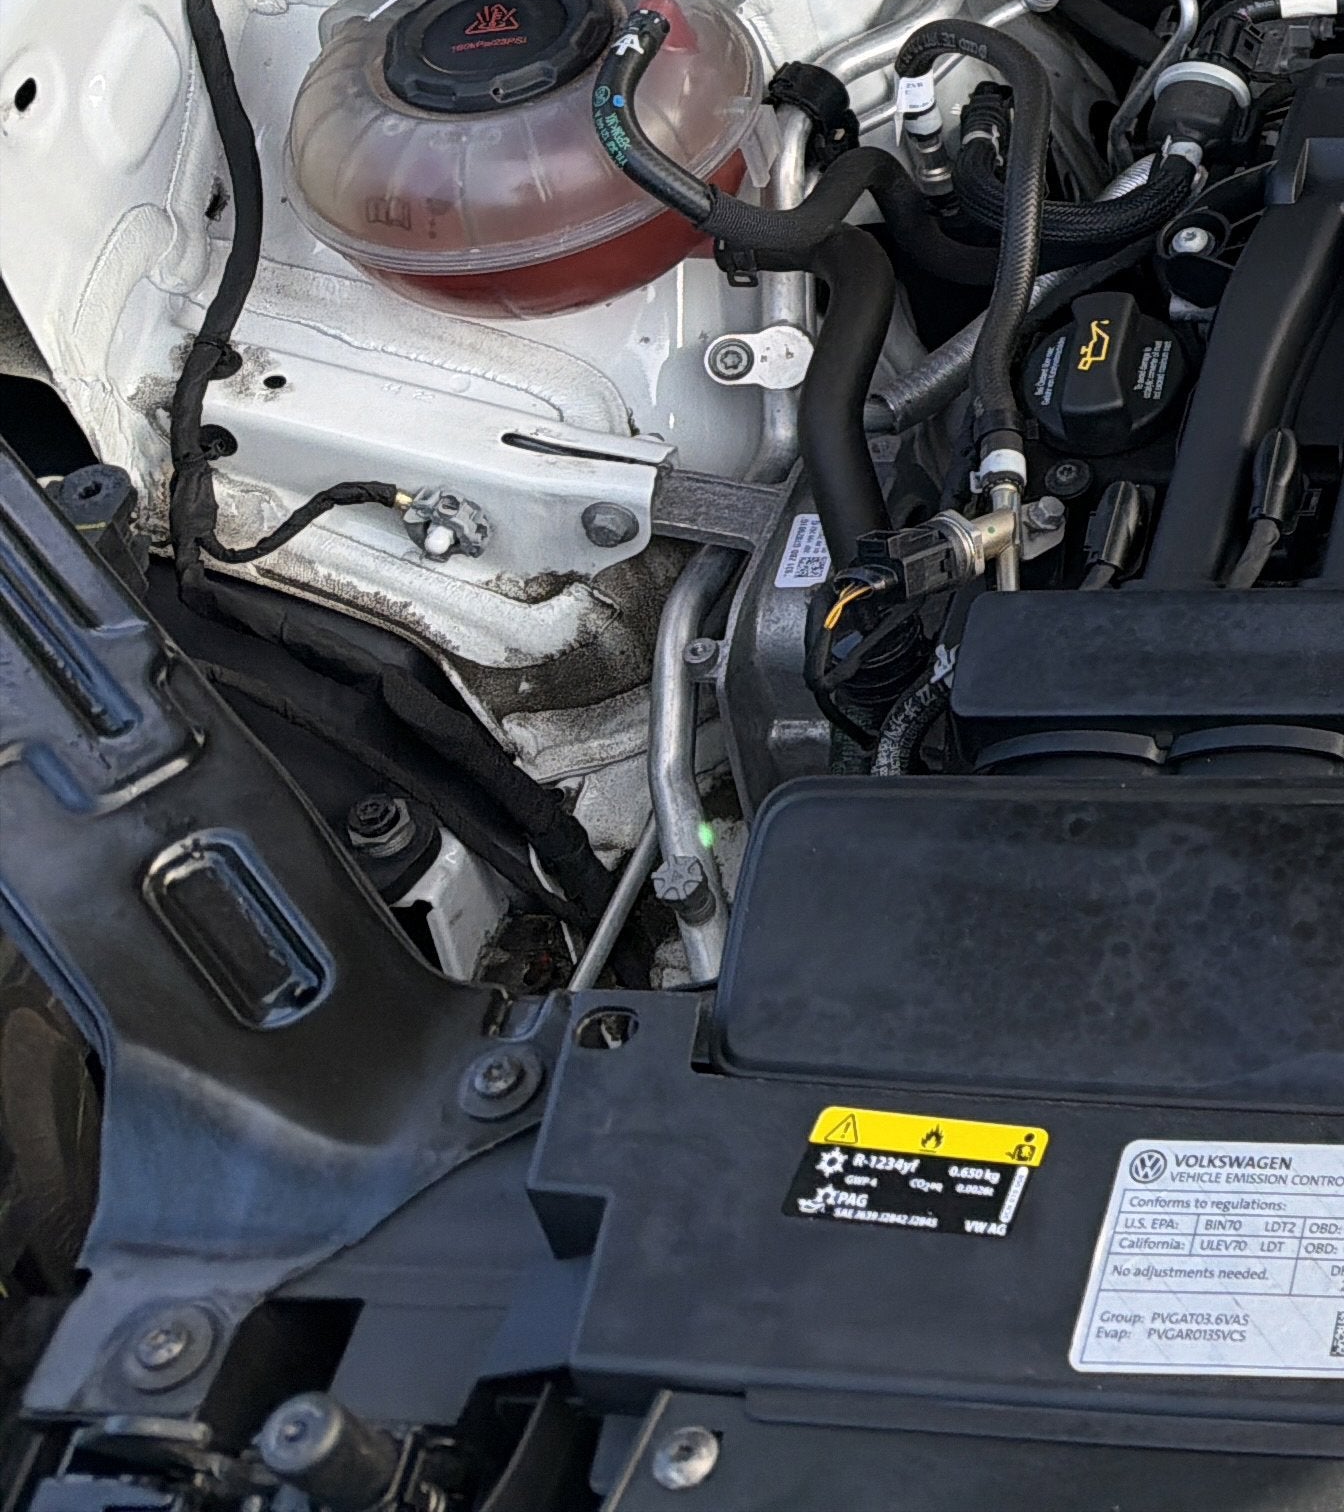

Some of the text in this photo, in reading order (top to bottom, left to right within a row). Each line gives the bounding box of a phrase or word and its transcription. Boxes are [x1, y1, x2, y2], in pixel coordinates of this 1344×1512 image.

[853, 1153, 920, 1175] R-1234yf
[1174, 1153, 1293, 1171] VOLKSWAGEN
[948, 1165, 1000, 1184] 0.650 kg
[1170, 1171, 1222, 1184] VEHICLE
[1225, 1172, 1288, 1185] EMISSION
[837, 1191, 868, 1208] PAG
[1129, 1196, 1286, 1212] Conforms to regulations:
[833, 1207, 854, 1219] SAE
[964, 1219, 1007, 1236] VW AG
[1125, 1217, 1179, 1230] U.S. EPA:
[1204, 1219, 1297, 1234] BIN70 LDT2
[1308, 1223, 1342, 1235] OBD:
[1118, 1235, 1185, 1250] California:
[1199, 1239, 1286, 1252] ULEV70 LDT
[1304, 1243, 1337, 1254] OBD:
[1112, 1265, 1269, 1280] No adjustments needed.
[1100, 1311, 1249, 1326] Group: PVGAT03.6VAS
[1095, 1327, 1132, 1342] Evap:
